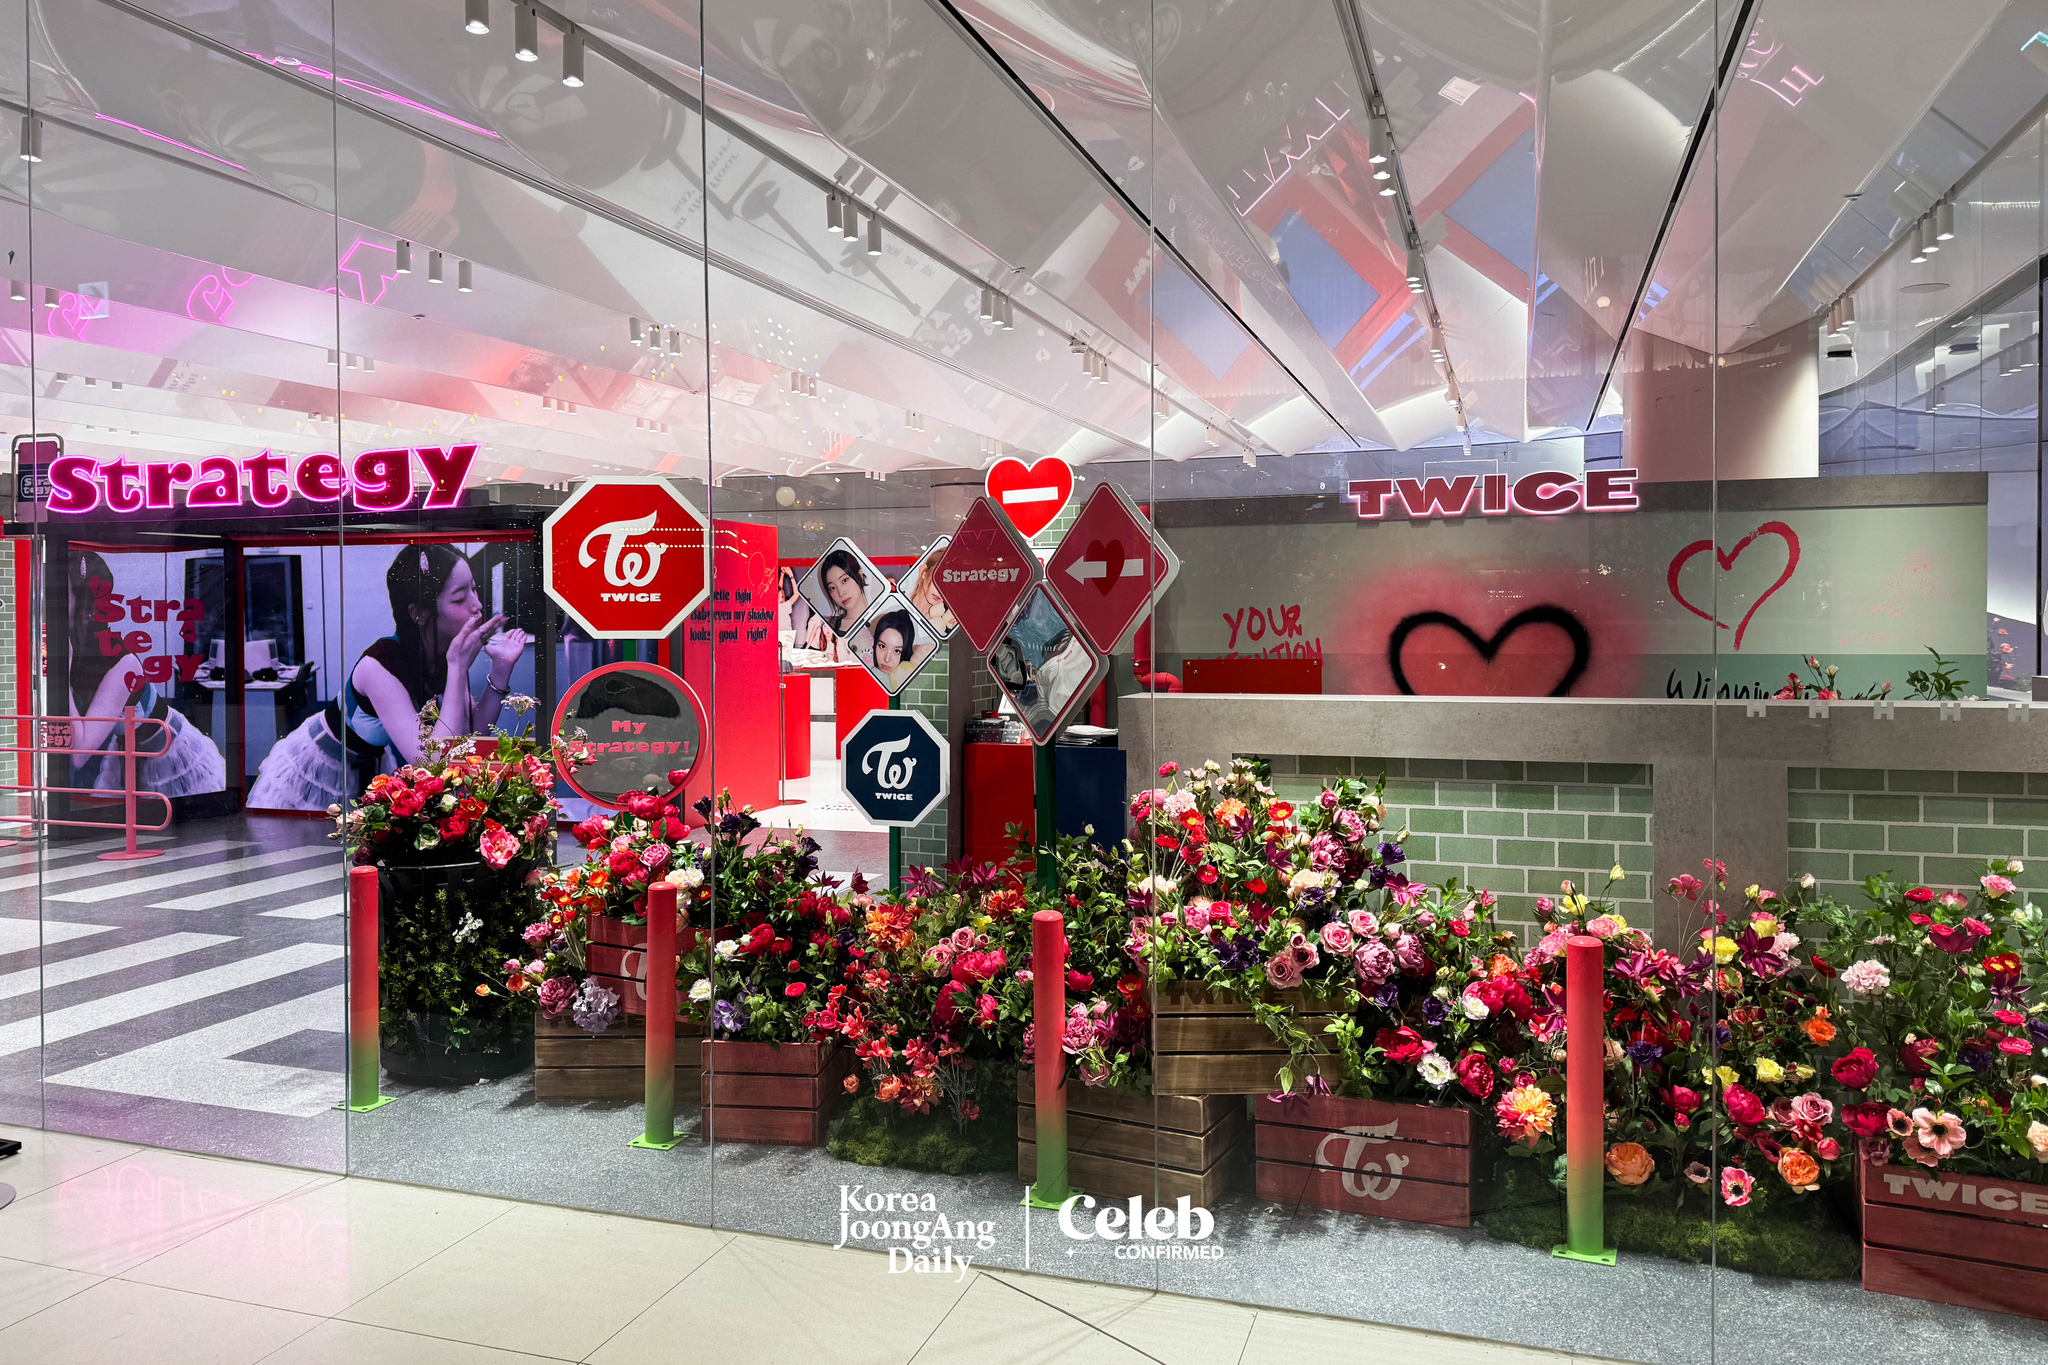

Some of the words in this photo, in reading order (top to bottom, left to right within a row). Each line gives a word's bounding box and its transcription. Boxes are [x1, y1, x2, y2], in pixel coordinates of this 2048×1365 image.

[46, 443, 482, 514] Strategy
[1347, 468, 1639, 517] TWICE
[943, 568, 1020, 582] Strategy
[600, 593, 662, 602] TWICE
[94, 594, 204, 624] Stra
[734, 610, 746, 624] my
[747, 607, 775, 621] shadow
[718, 627, 739, 643] good
[1223, 604, 1303, 650] YOUR
[611, 720, 647, 735] My
[569, 740, 690, 755] Strategy!
[875, 792, 914, 801] TWICE
[1883, 1173, 2048, 1215] TWICE
